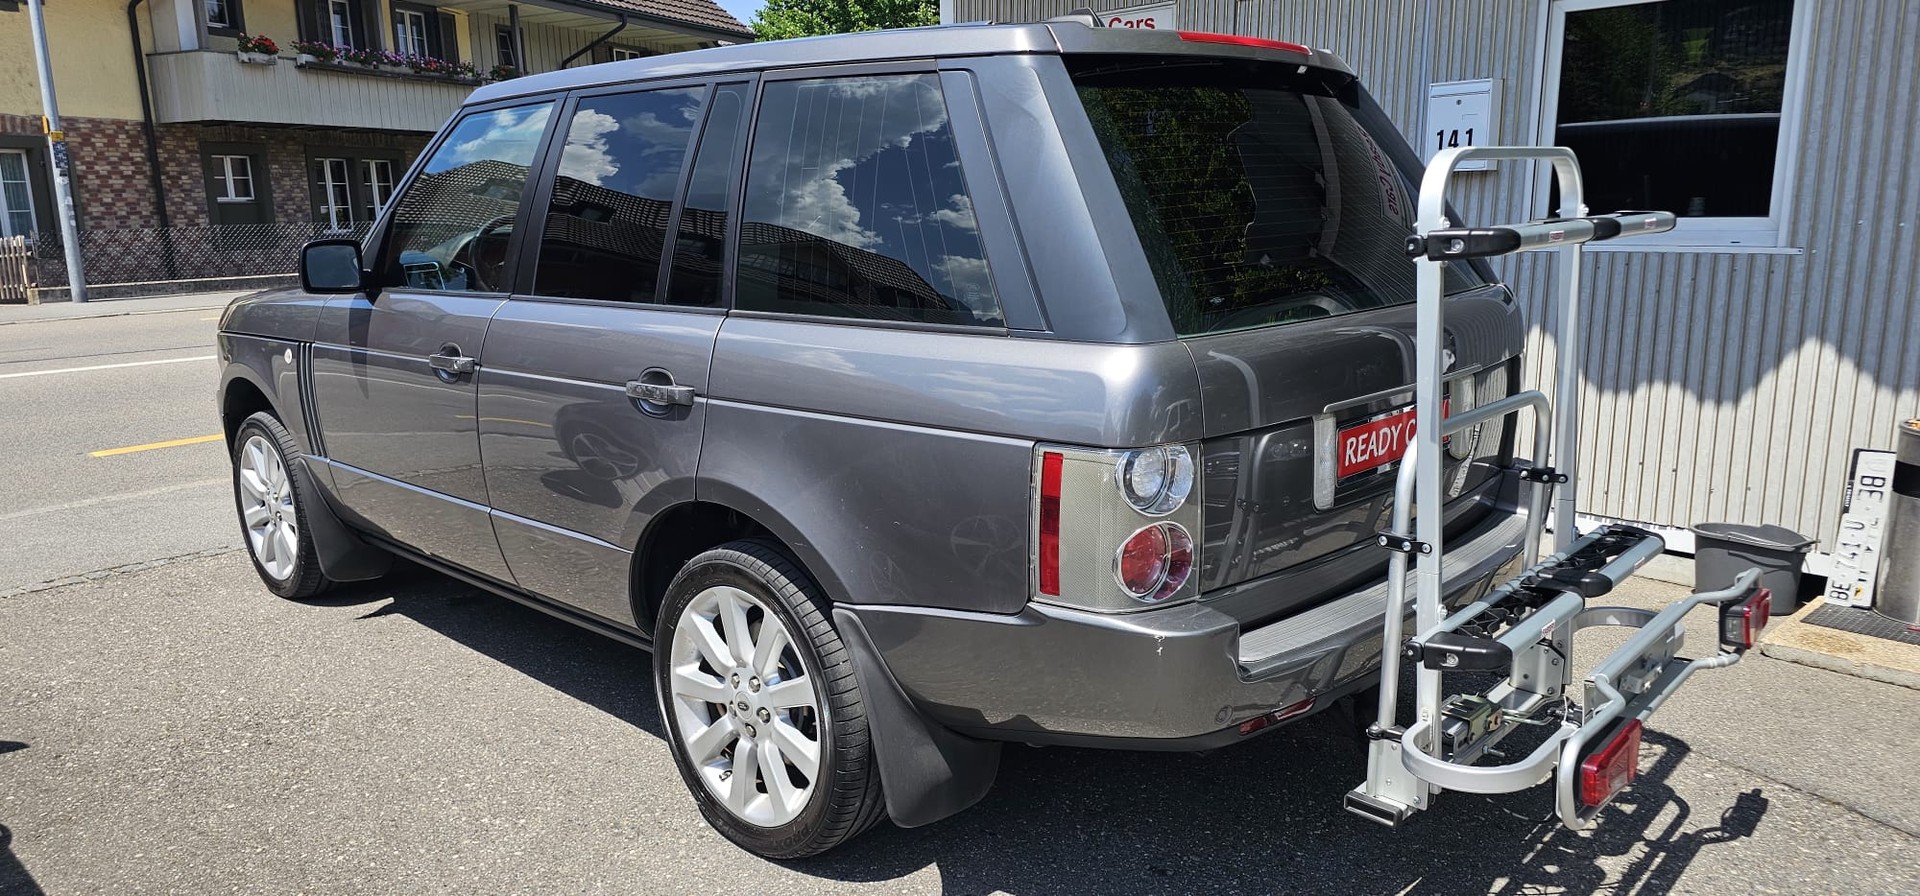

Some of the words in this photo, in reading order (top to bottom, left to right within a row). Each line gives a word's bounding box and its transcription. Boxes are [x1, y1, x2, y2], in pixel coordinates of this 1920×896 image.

[1109, 16, 1156, 29] Cars
[1436, 127, 1474, 151] 141
[1344, 422, 1402, 467] READY
